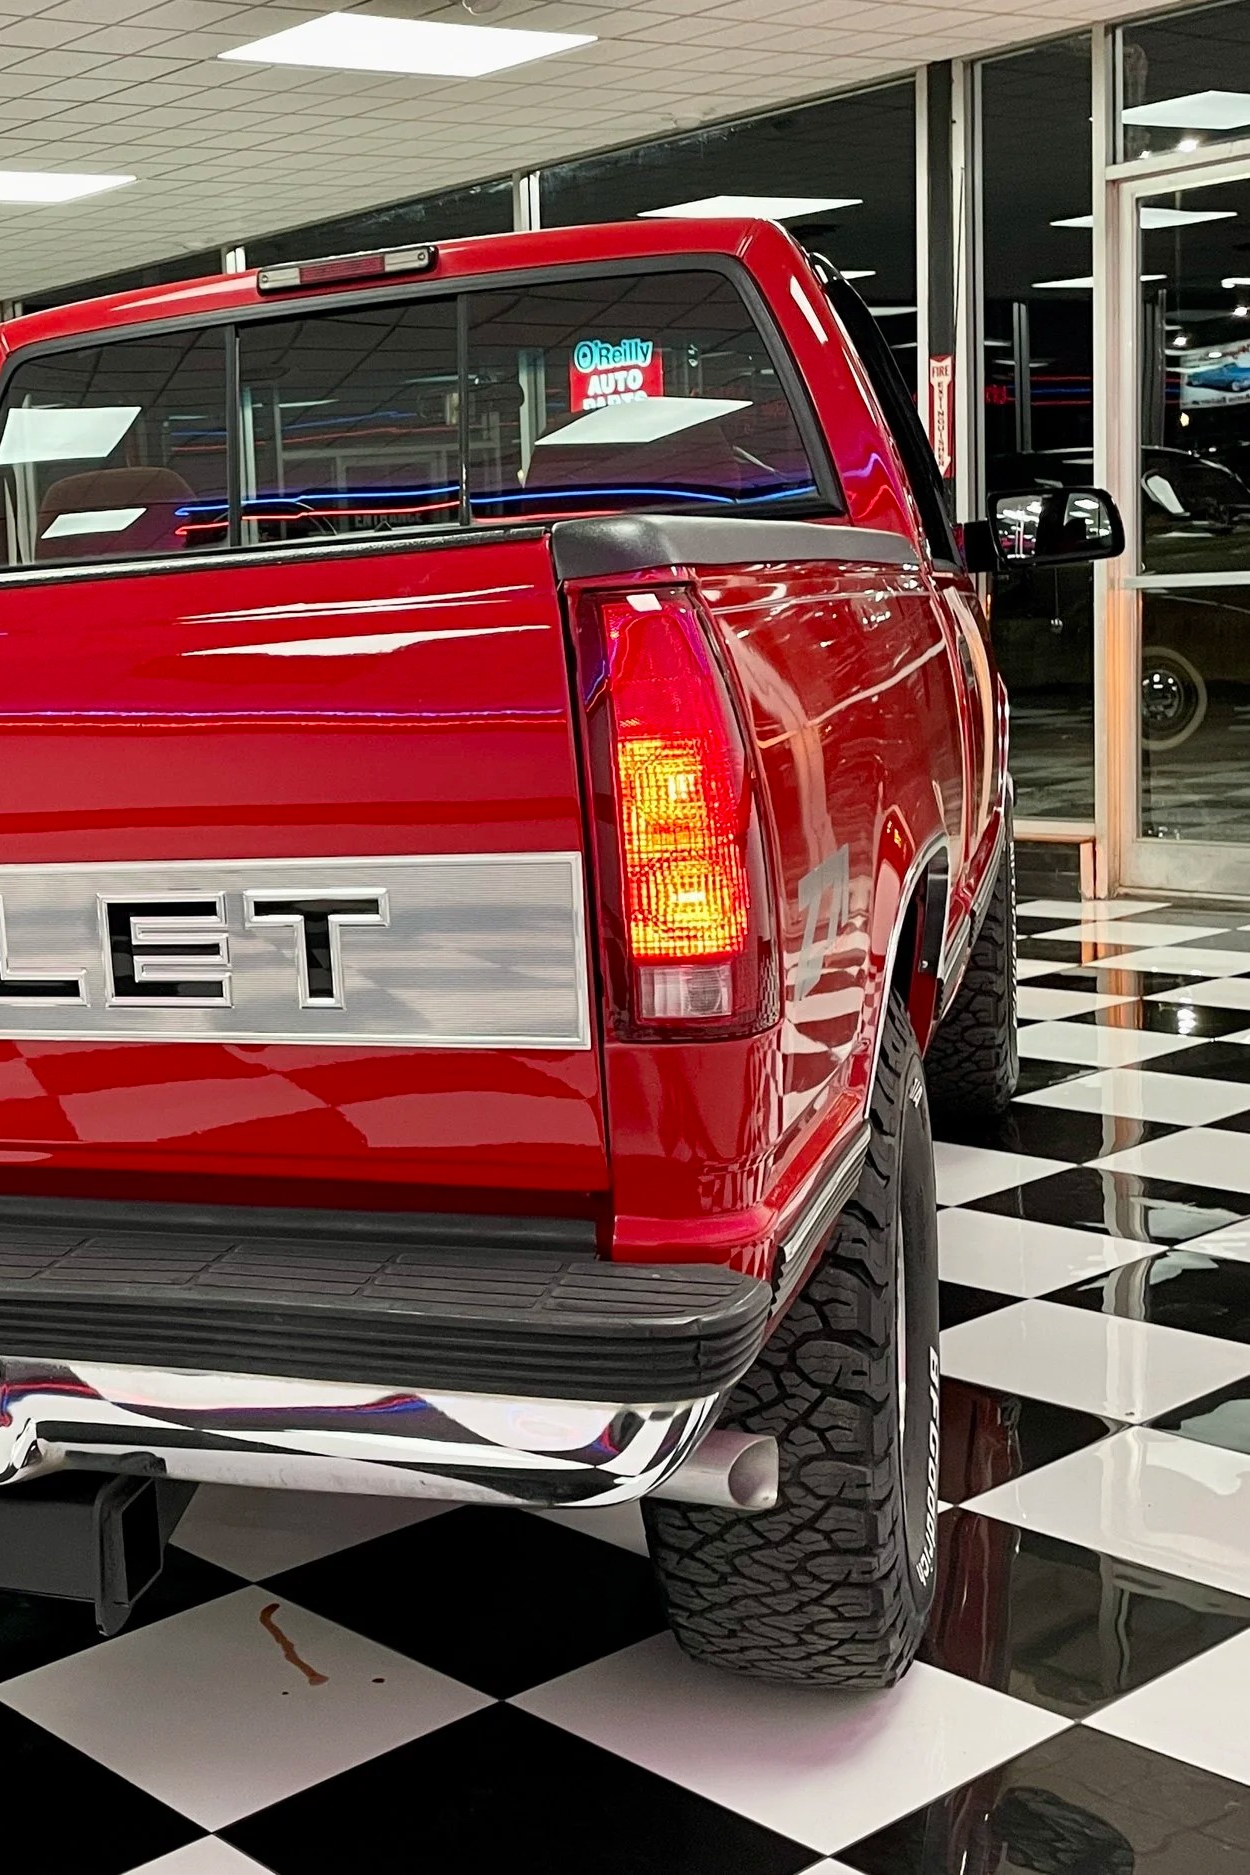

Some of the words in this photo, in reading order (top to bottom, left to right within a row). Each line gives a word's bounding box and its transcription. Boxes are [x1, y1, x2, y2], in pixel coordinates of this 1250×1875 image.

[575, 339, 652, 371] O'Reilly
[587, 369, 643, 396] AUTO
[932, 365, 949, 378] FIRE
